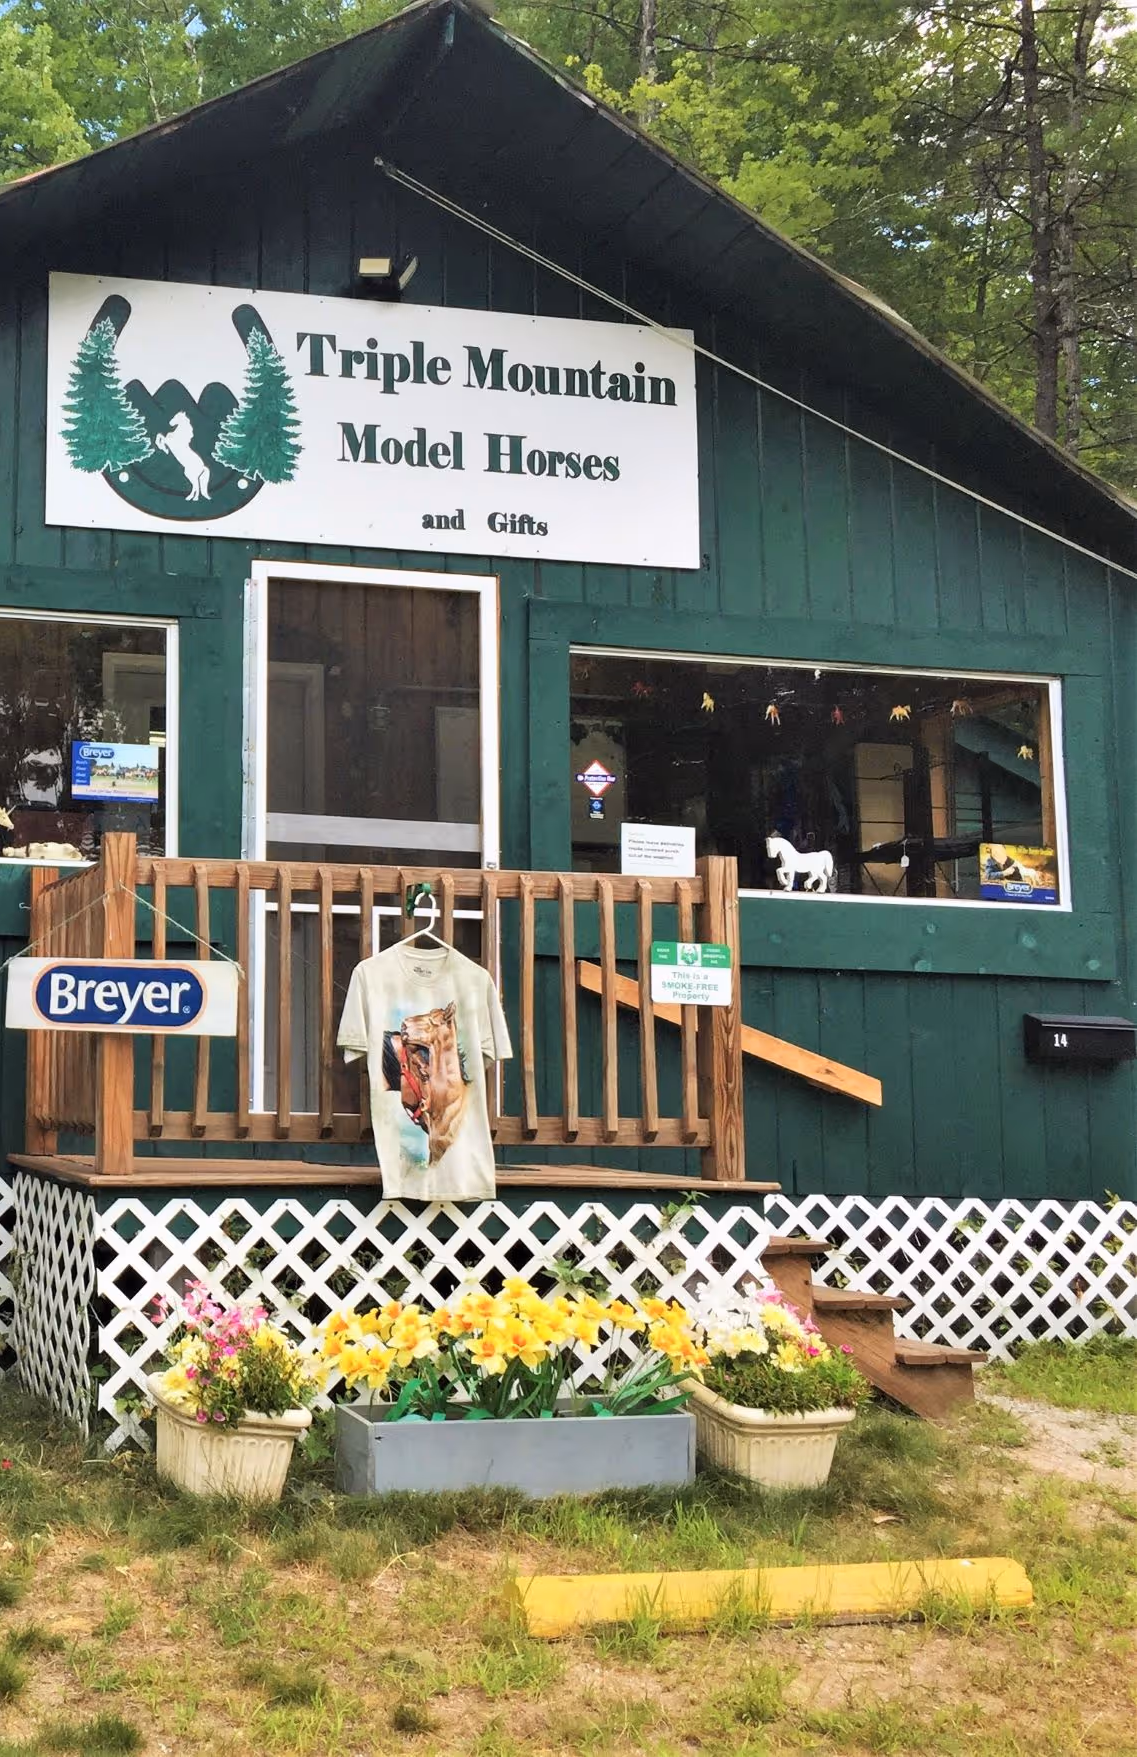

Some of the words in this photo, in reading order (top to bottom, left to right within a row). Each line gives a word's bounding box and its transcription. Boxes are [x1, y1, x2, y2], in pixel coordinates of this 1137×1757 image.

[296, 332, 452, 394] Triple
[463, 345, 678, 406] Mountain
[336, 421, 464, 472] Model
[483, 432, 621, 482] Horses
[421, 508, 466, 531] and
[487, 511, 549, 537] Gifts
[83, 747, 113, 758] Breyer
[1006, 883, 1031, 893] Breyer
[671, 971, 690, 979] This
[692, 972, 701, 980] is
[661, 981, 719, 992] SMOKE-FREE
[49, 972, 192, 1025] Breyer
[672, 991, 710, 1002] Property
[1053, 1033, 1068, 1048] 14
